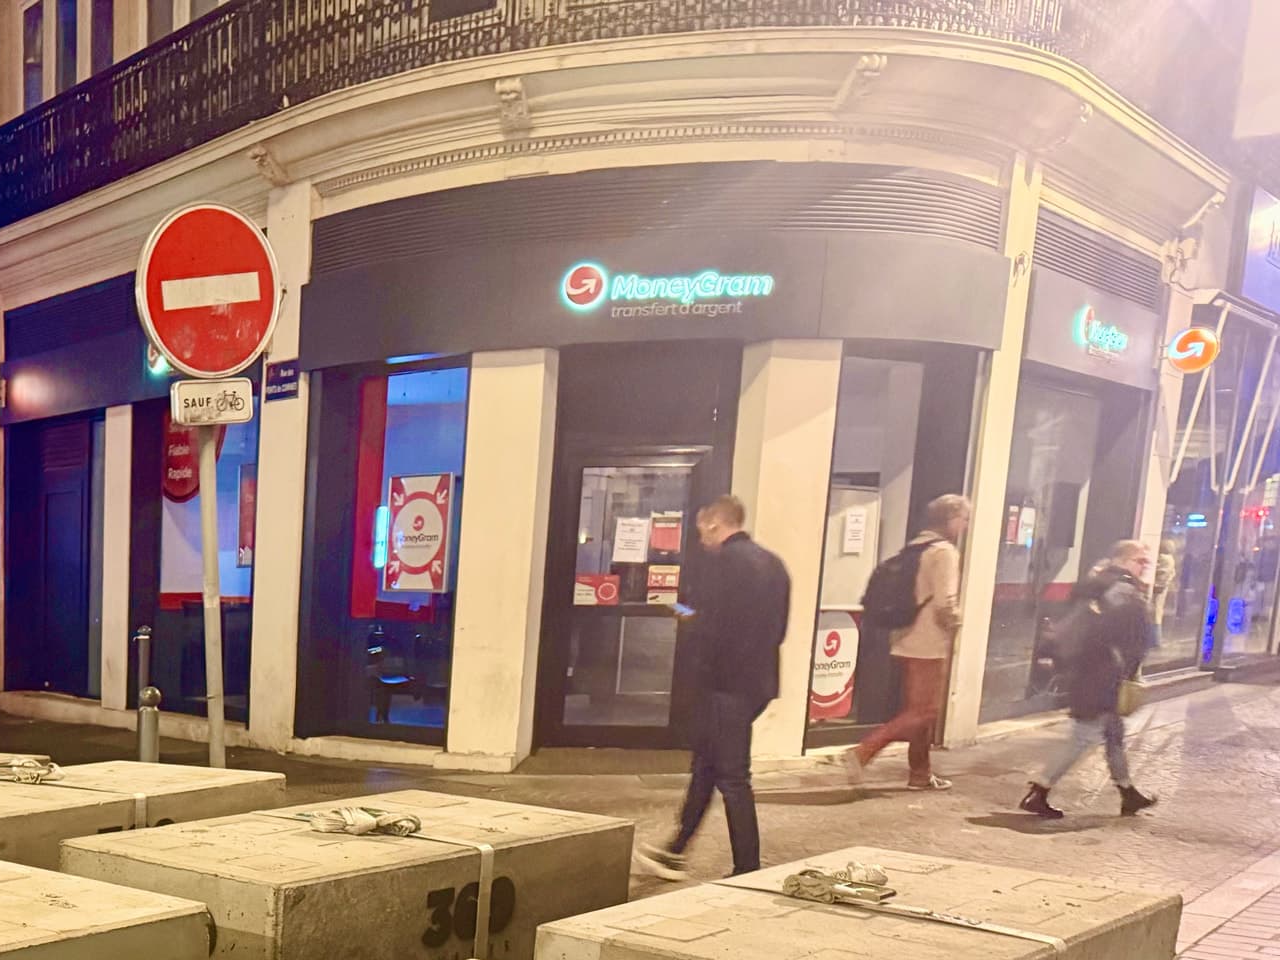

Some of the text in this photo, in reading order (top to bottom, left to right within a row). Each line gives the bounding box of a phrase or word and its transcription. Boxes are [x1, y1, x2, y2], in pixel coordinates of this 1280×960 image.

[610, 271, 774, 304] MoneyGram
[611, 301, 743, 318] transfert d'argent
[183, 397, 212, 409] SAUF
[815, 660, 851, 671] oneyGram
